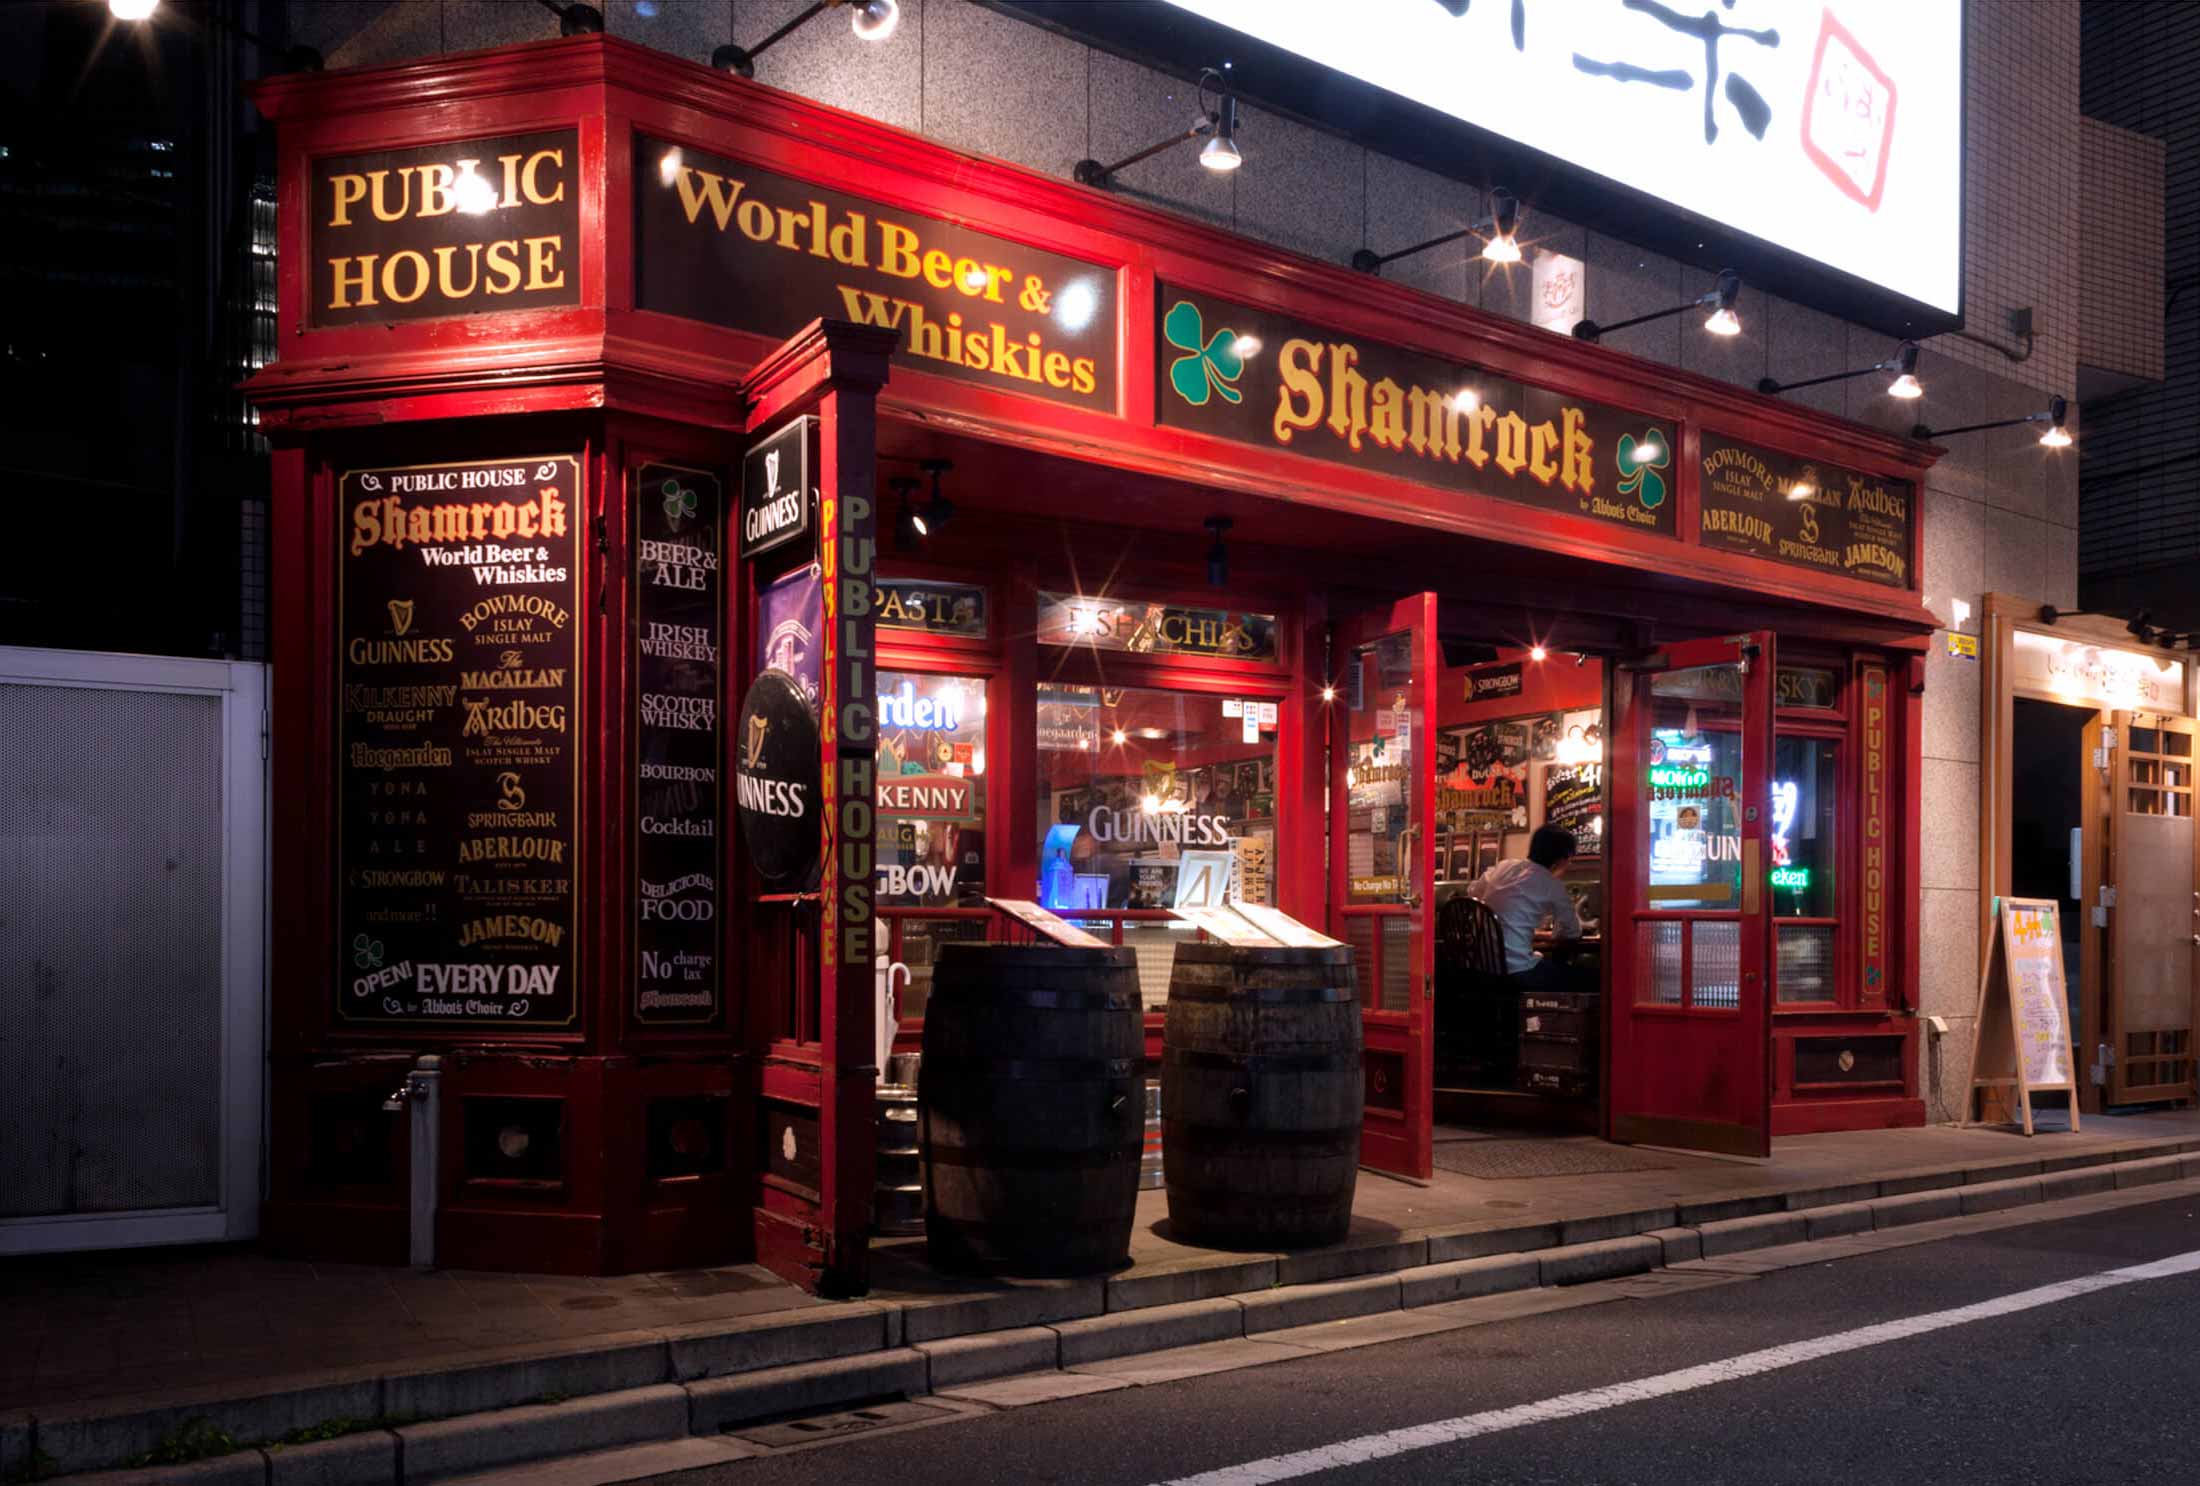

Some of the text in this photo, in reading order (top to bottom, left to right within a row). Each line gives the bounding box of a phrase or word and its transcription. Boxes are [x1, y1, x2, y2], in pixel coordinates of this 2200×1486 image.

[329, 149, 563, 226] PUBLIC
[673, 165, 1051, 313] World Beer &
[328, 236, 564, 308] HOUSE
[838, 285, 1096, 394] Whiskies
[1273, 339, 1596, 495] Shamrock
[391, 468, 526, 492] PUBLIC HOUSE
[1702, 448, 1774, 491] BOWMORE
[1725, 470, 1750, 486] ISLAY
[1777, 476, 1841, 505] MALLAN
[352, 487, 567, 557] Shamrock
[746, 491, 799, 542] GUINNESS
[1702, 509, 1772, 545] ABERLOUR
[421, 544, 549, 567] World Beer &
[640, 538, 718, 570] BEER &
[1844, 543, 1906, 578] JAMESON
[472, 564, 567, 585] Whiskies
[652, 562, 707, 591] ALE
[458, 594, 569, 632] BOWMORE
[494, 618, 533, 632] ISLAY
[1067, 606, 1134, 640] FSH
[474, 632, 552, 645] SINGLE MALT
[649, 621, 709, 645] IRISH
[350, 637, 455, 665] GUINNESS
[498, 650, 523, 669] The
[640, 638, 717, 663] WHISKEY
[460, 669, 567, 689] MACALLAN
[345, 683, 457, 712] KILKENNY
[640, 692, 715, 716] SCOTCH
[367, 710, 434, 723] DRAUGHT
[640, 708, 716, 732] WHISKY
[843, 496, 872, 964] PUBLIC HOUSE
[639, 763, 715, 783] BOURBON
[878, 785, 966, 811] KENNY
[640, 816, 714, 837] Cocktail
[1089, 805, 1230, 847] GUINNESS
[1867, 708, 1881, 957] PUBLIC HOUSE
[457, 836, 563, 865] ABERLOUR
[361, 871, 446, 889] STRONGBOW
[453, 874, 568, 895] TALISKER
[640, 872, 714, 898] DELICIOUS
[640, 899, 714, 920] FOOD
[457, 915, 562, 948] JAMESON
[641, 950, 672, 979] No
[673, 950, 712, 968] charge
[416, 963, 505, 994] EVERY
[506, 964, 560, 995] DAY
[683, 967, 704, 980] tax
